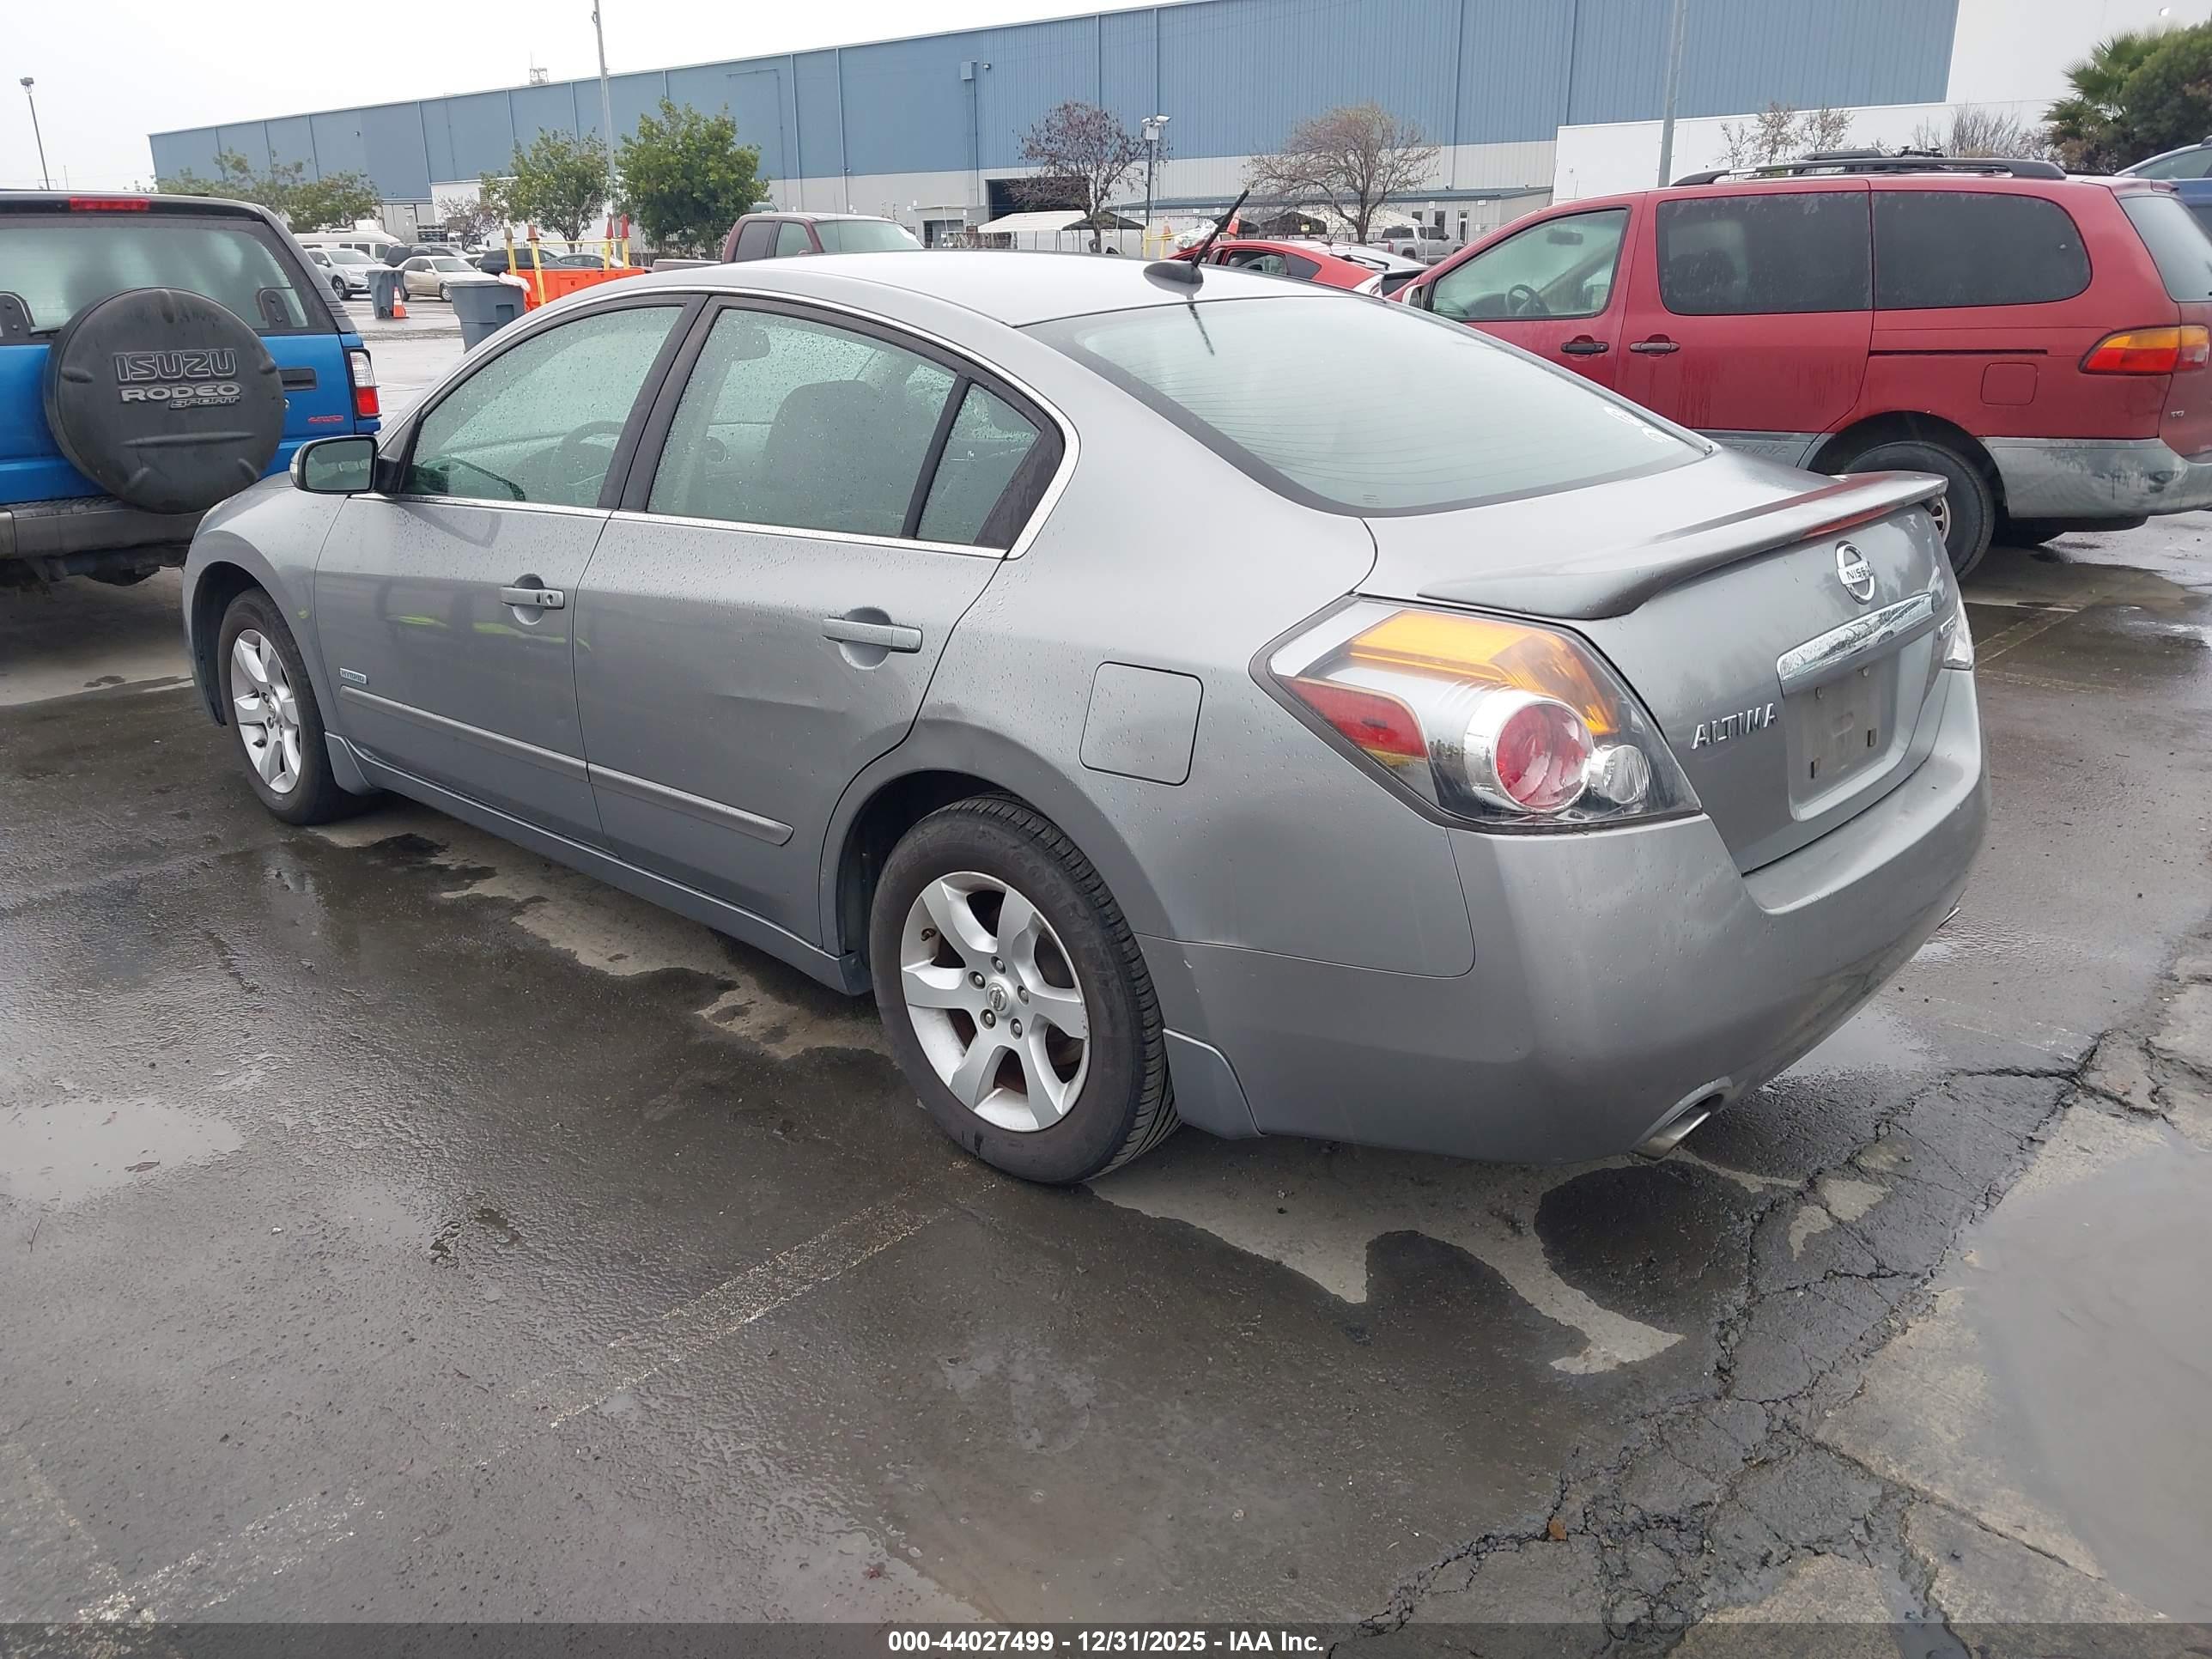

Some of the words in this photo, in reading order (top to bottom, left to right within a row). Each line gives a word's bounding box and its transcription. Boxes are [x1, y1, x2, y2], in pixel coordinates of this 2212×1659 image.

[116, 349, 236, 381] ISUZU
[120, 385, 241, 402] RODEO
[170, 396, 240, 409] SPORT
[1691, 702, 1778, 750] ALTIMA
